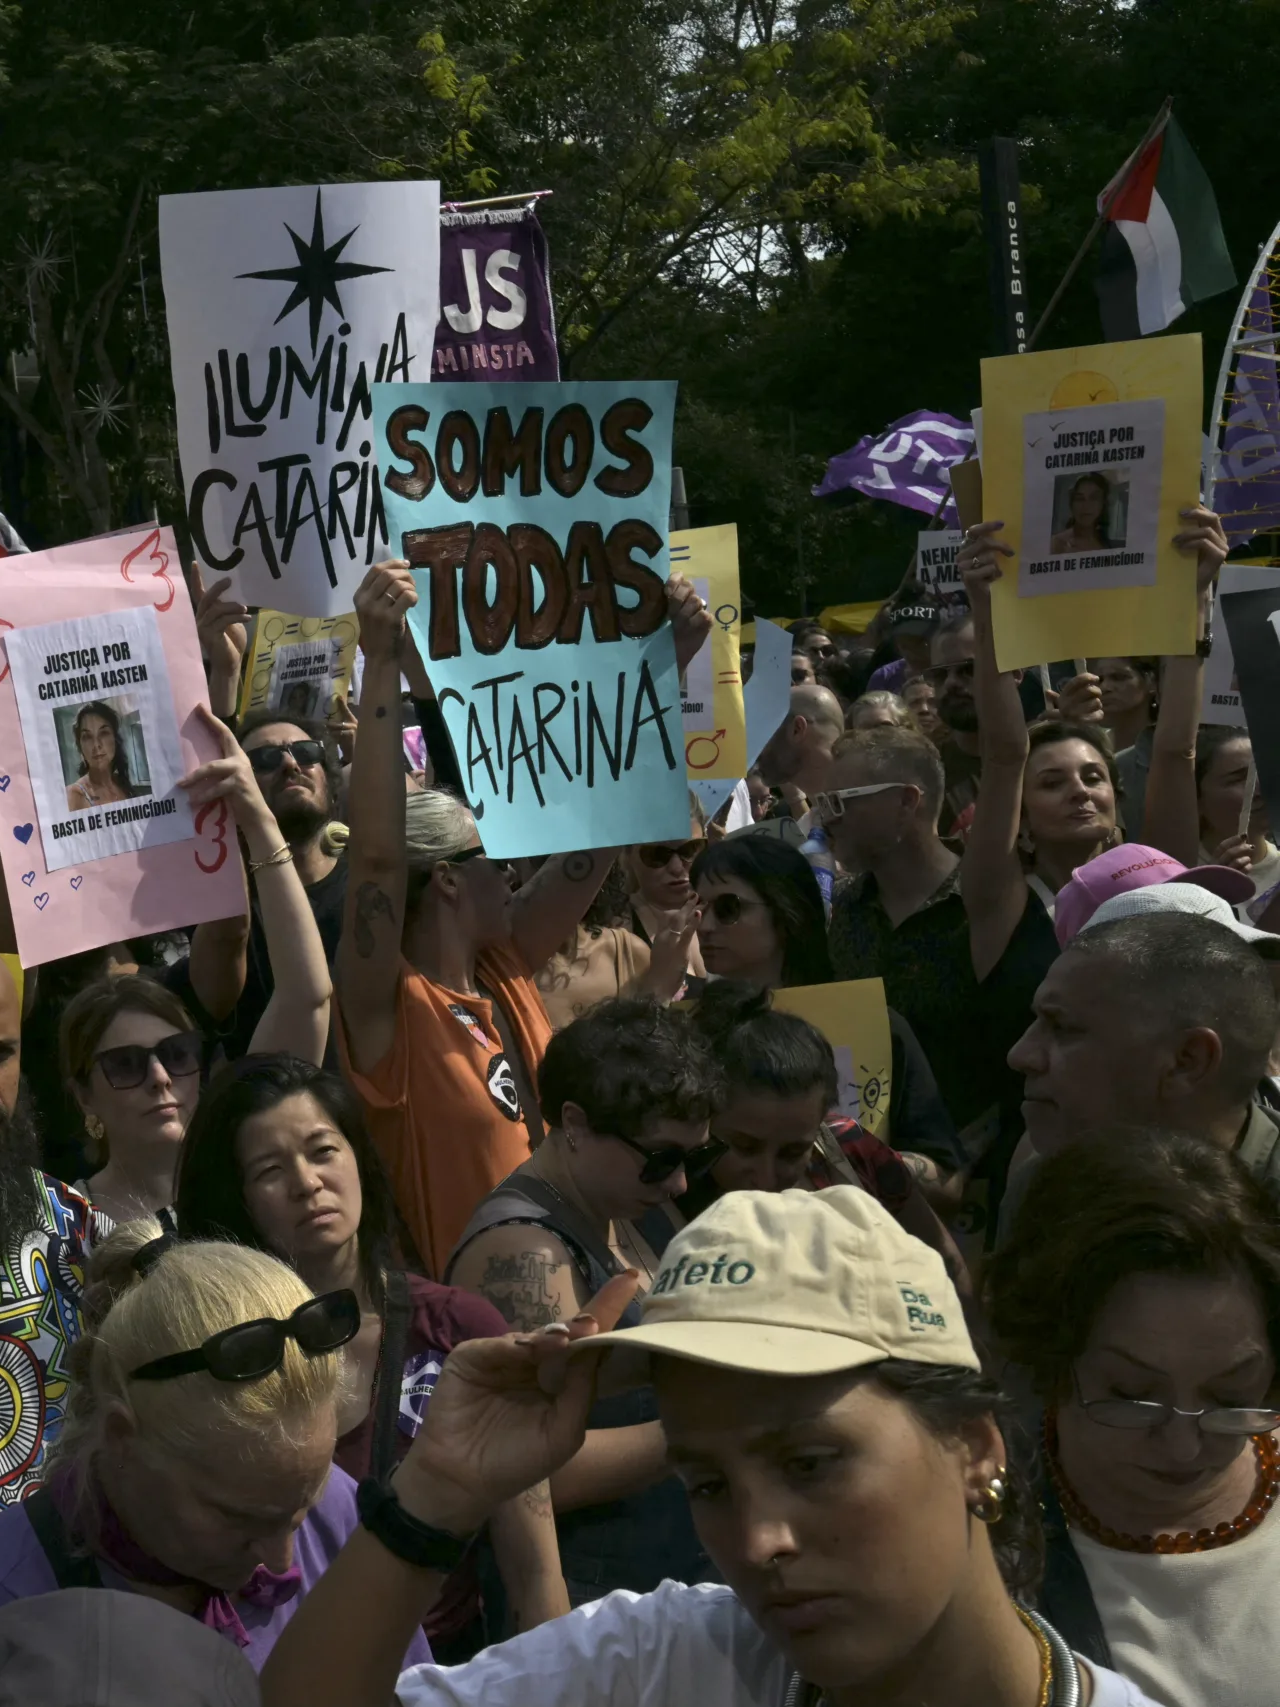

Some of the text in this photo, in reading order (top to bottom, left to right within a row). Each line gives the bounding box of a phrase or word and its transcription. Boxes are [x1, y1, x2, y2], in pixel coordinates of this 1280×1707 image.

[1007, 201, 1023, 295] Branca
[431, 340, 535, 374] MINSTA
[384, 397, 654, 503] SOMOS
[1053, 426, 1135, 450] JUSTIÇA POR
[1045, 445, 1145, 469] CATARINA KASTEN
[1029, 551, 1145, 575] BASTA DE FEMINICÍDIO!
[401, 518, 669, 661] TODAS
[43, 641, 132, 675] JUSTIÇA POR
[312, 653, 326, 665] POR
[38, 664, 149, 701] CATARINA KASTEN
[1210, 694, 1240, 706] BASTA
[52, 797, 177, 840] BASTA DE FEMINICÍDIO!
[651, 1253, 756, 1296] afeto
[899, 1287, 932, 1308] Da
[906, 1305, 947, 1329] Rua
